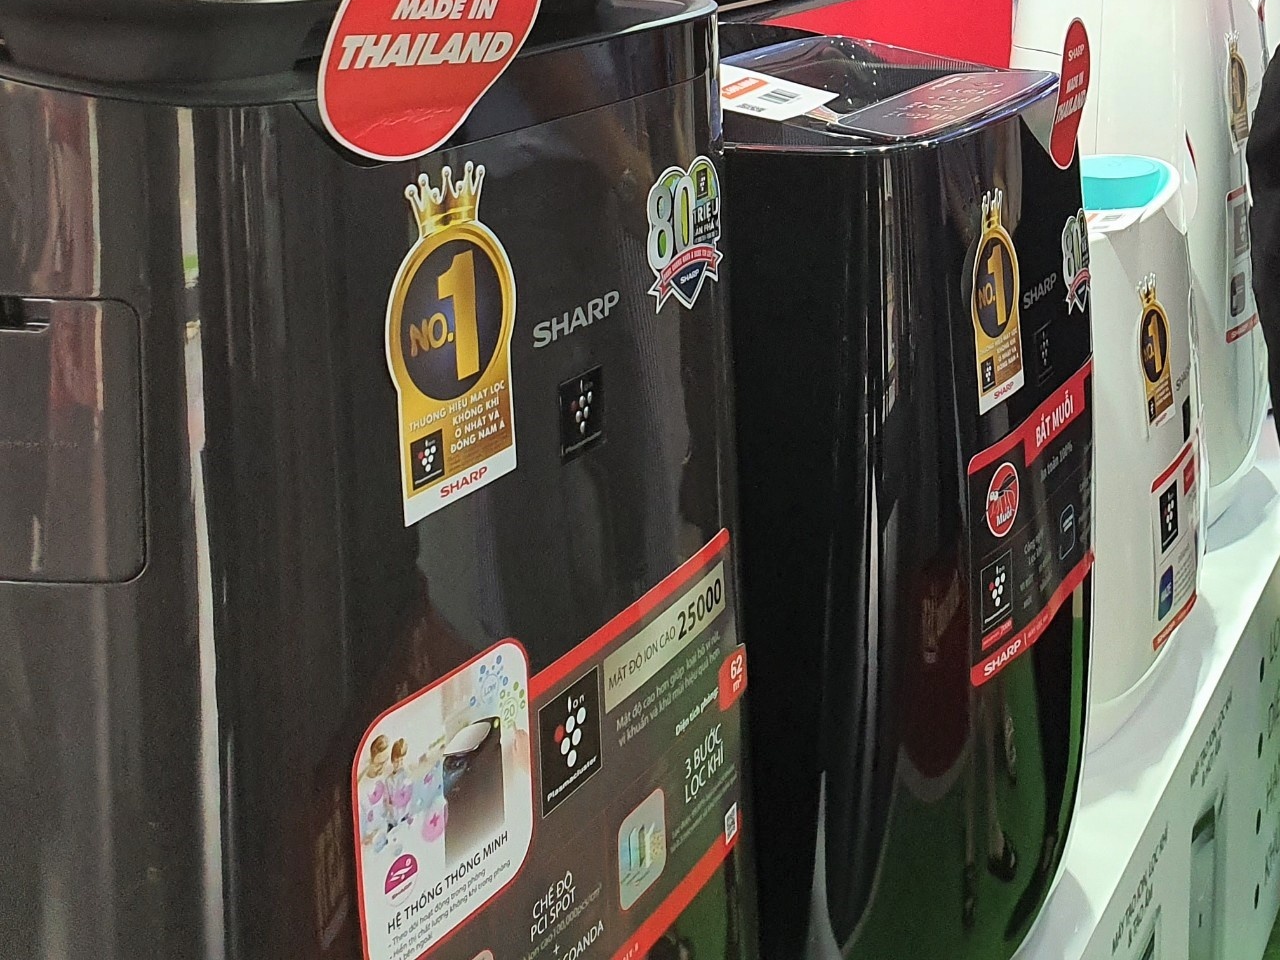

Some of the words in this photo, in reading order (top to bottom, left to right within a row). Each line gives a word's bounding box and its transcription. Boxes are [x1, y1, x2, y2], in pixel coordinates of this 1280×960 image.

[337, 31, 515, 71] THAILAND
[1067, 43, 1085, 62] SHARP
[649, 174, 696, 270] 80
[680, 268, 700, 285] SHARP
[1023, 272, 1057, 310] SHARP
[532, 290, 620, 348] SHARP
[994, 381, 1015, 400] SHARP
[478, 424, 498, 440] NAM
[440, 466, 488, 498] SHARP
[608, 666, 627, 690] MẬT
[628, 651, 642, 675] ĐỘ
[643, 642, 658, 661] ION
[659, 626, 676, 648] CAO
[676, 578, 721, 641] 25000
[730, 654, 743, 680] 62
[983, 639, 1021, 677] SHARP
[504, 704, 516, 721] 20
[568, 694, 586, 714] Ion
[547, 755, 598, 803] Plasmacluster
[684, 758, 692, 779] 3
[684, 766, 706, 804] LỌC
[707, 742, 724, 779] KHÍ
[387, 911, 401, 935] HỆ
[403, 887, 443, 920] THỐNG
[444, 852, 481, 888] THÔNG
[483, 830, 508, 860] MINH
[532, 882, 555, 919] CHẾ
[556, 870, 573, 900] ĐỘ
[530, 913, 548, 943] PCI
[549, 886, 576, 924] SPOT
